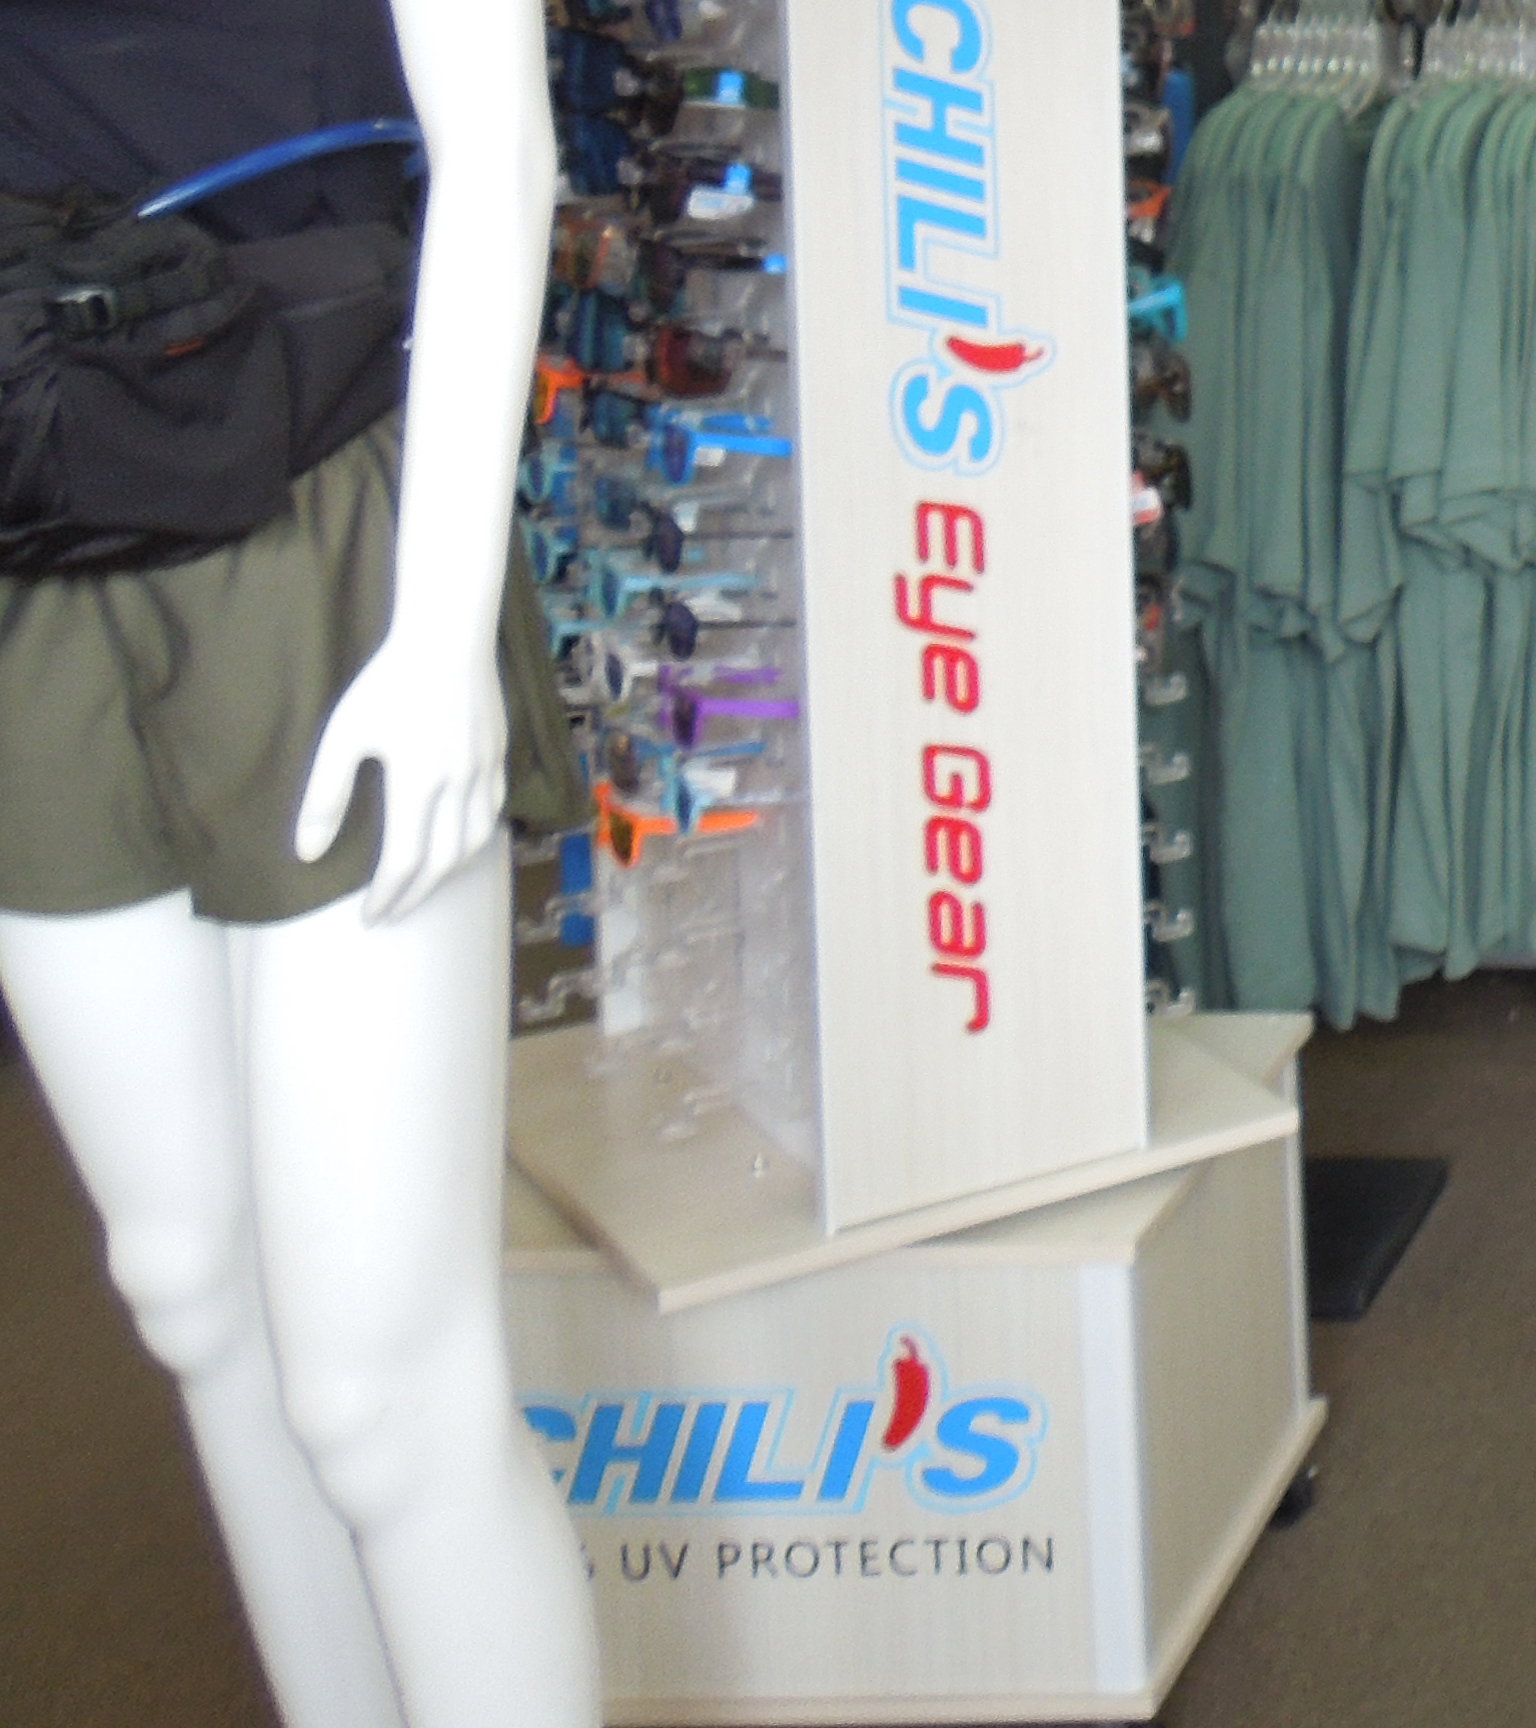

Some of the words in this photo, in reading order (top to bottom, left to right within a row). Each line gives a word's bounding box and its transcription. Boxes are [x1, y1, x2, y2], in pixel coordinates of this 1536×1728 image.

[894, 499, 986, 715] Eye
[921, 743, 992, 1035] Gear
[620, 1543, 690, 1582] UV
[717, 1536, 1056, 1582] PROTECTION
